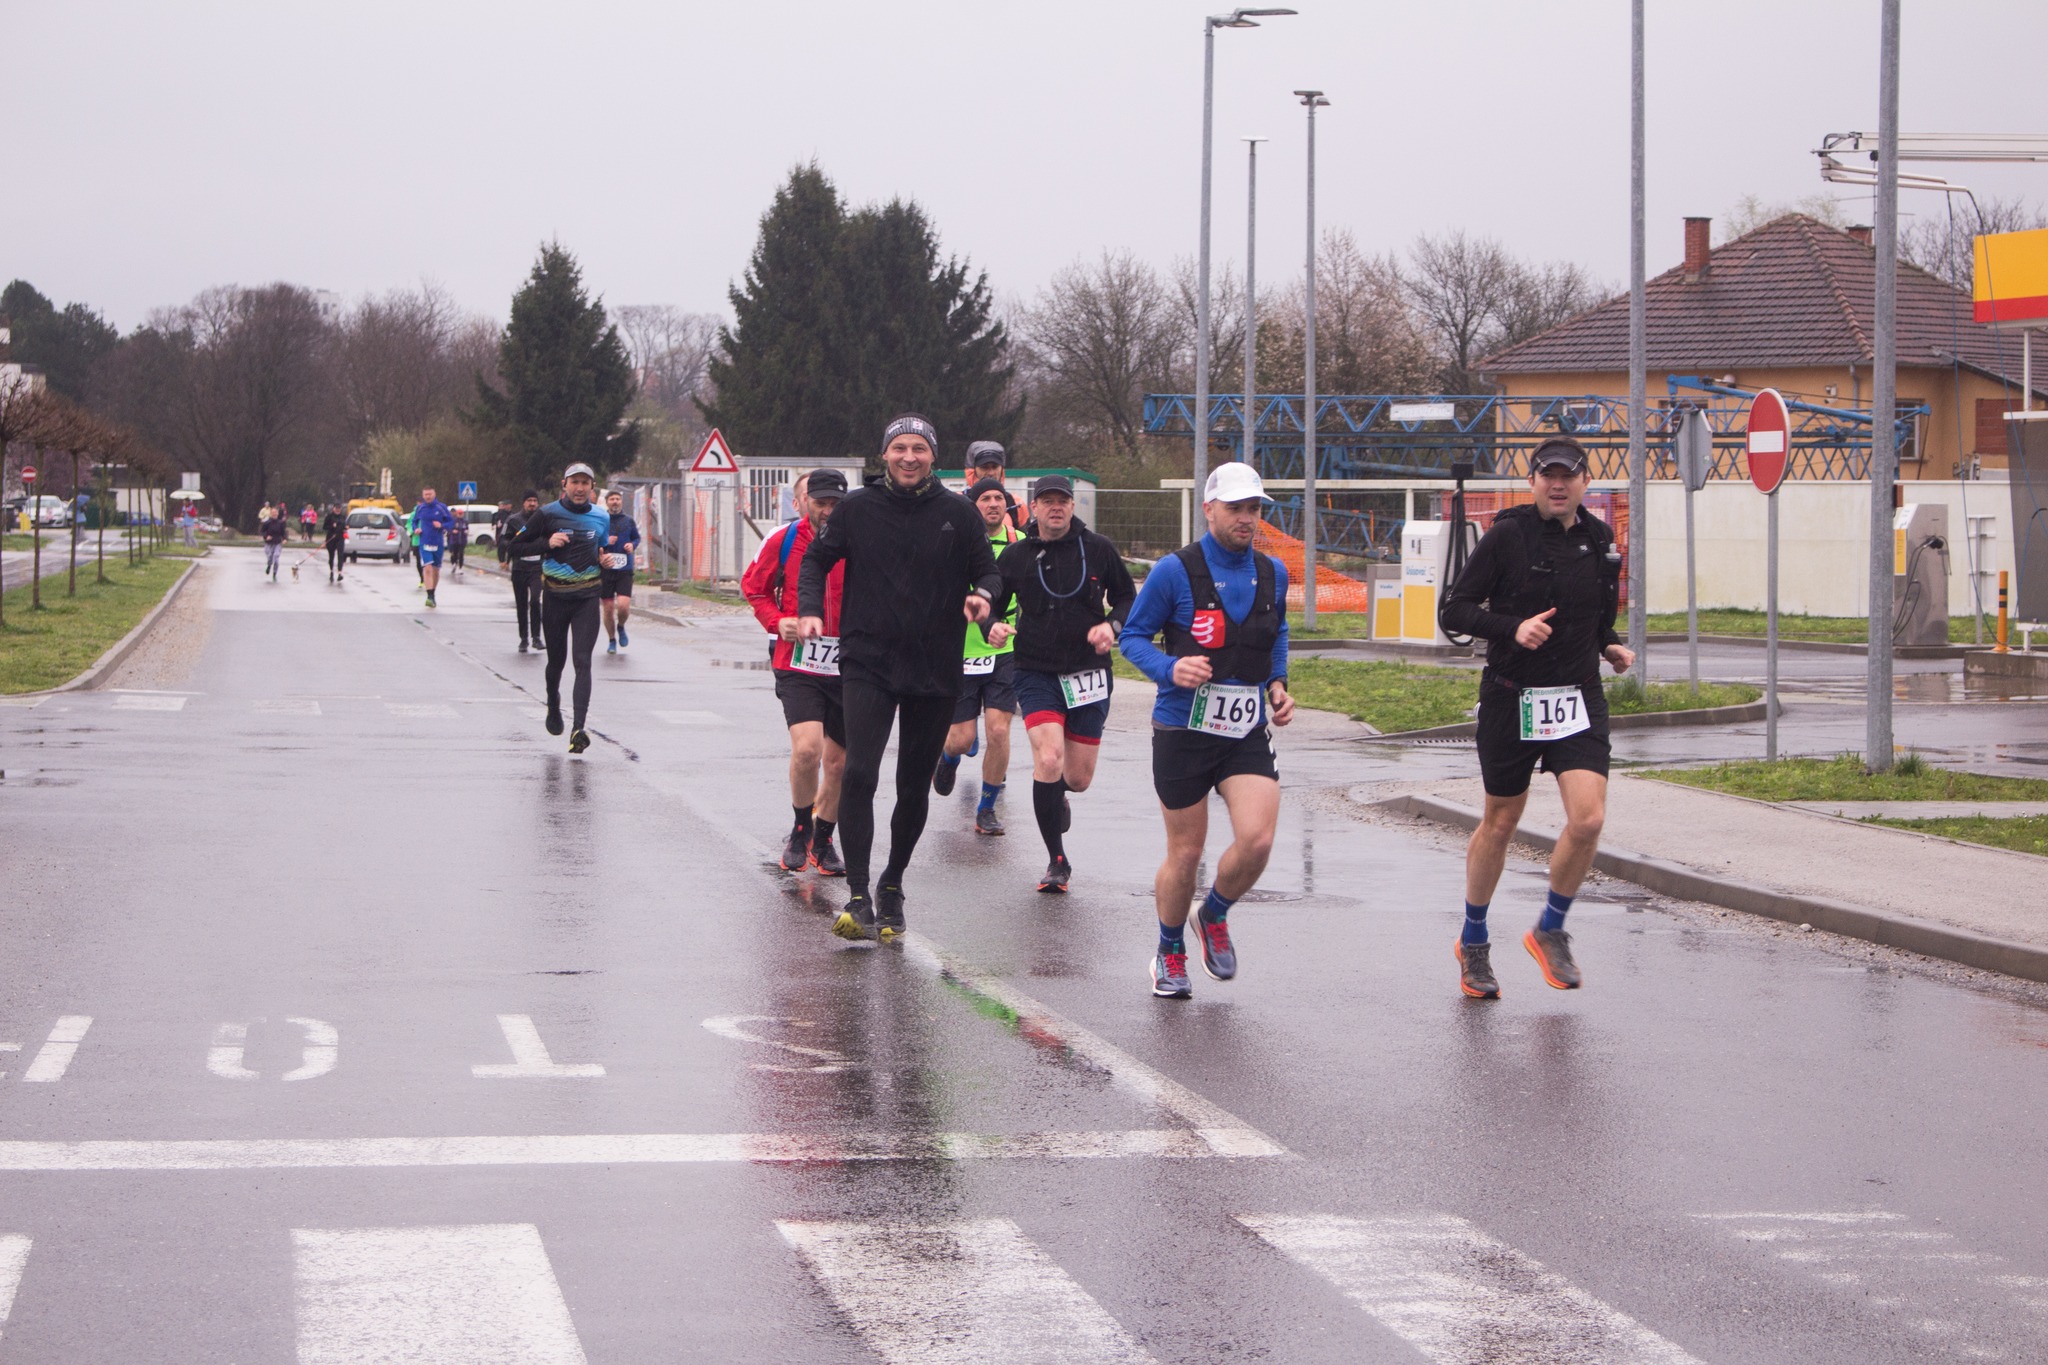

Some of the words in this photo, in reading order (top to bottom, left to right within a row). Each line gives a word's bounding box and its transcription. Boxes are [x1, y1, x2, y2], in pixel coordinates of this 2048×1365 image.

[808, 642, 840, 664] 172
[1073, 670, 1105, 693] 171
[1212, 696, 1257, 724] 169
[1539, 696, 1578, 725] 167
